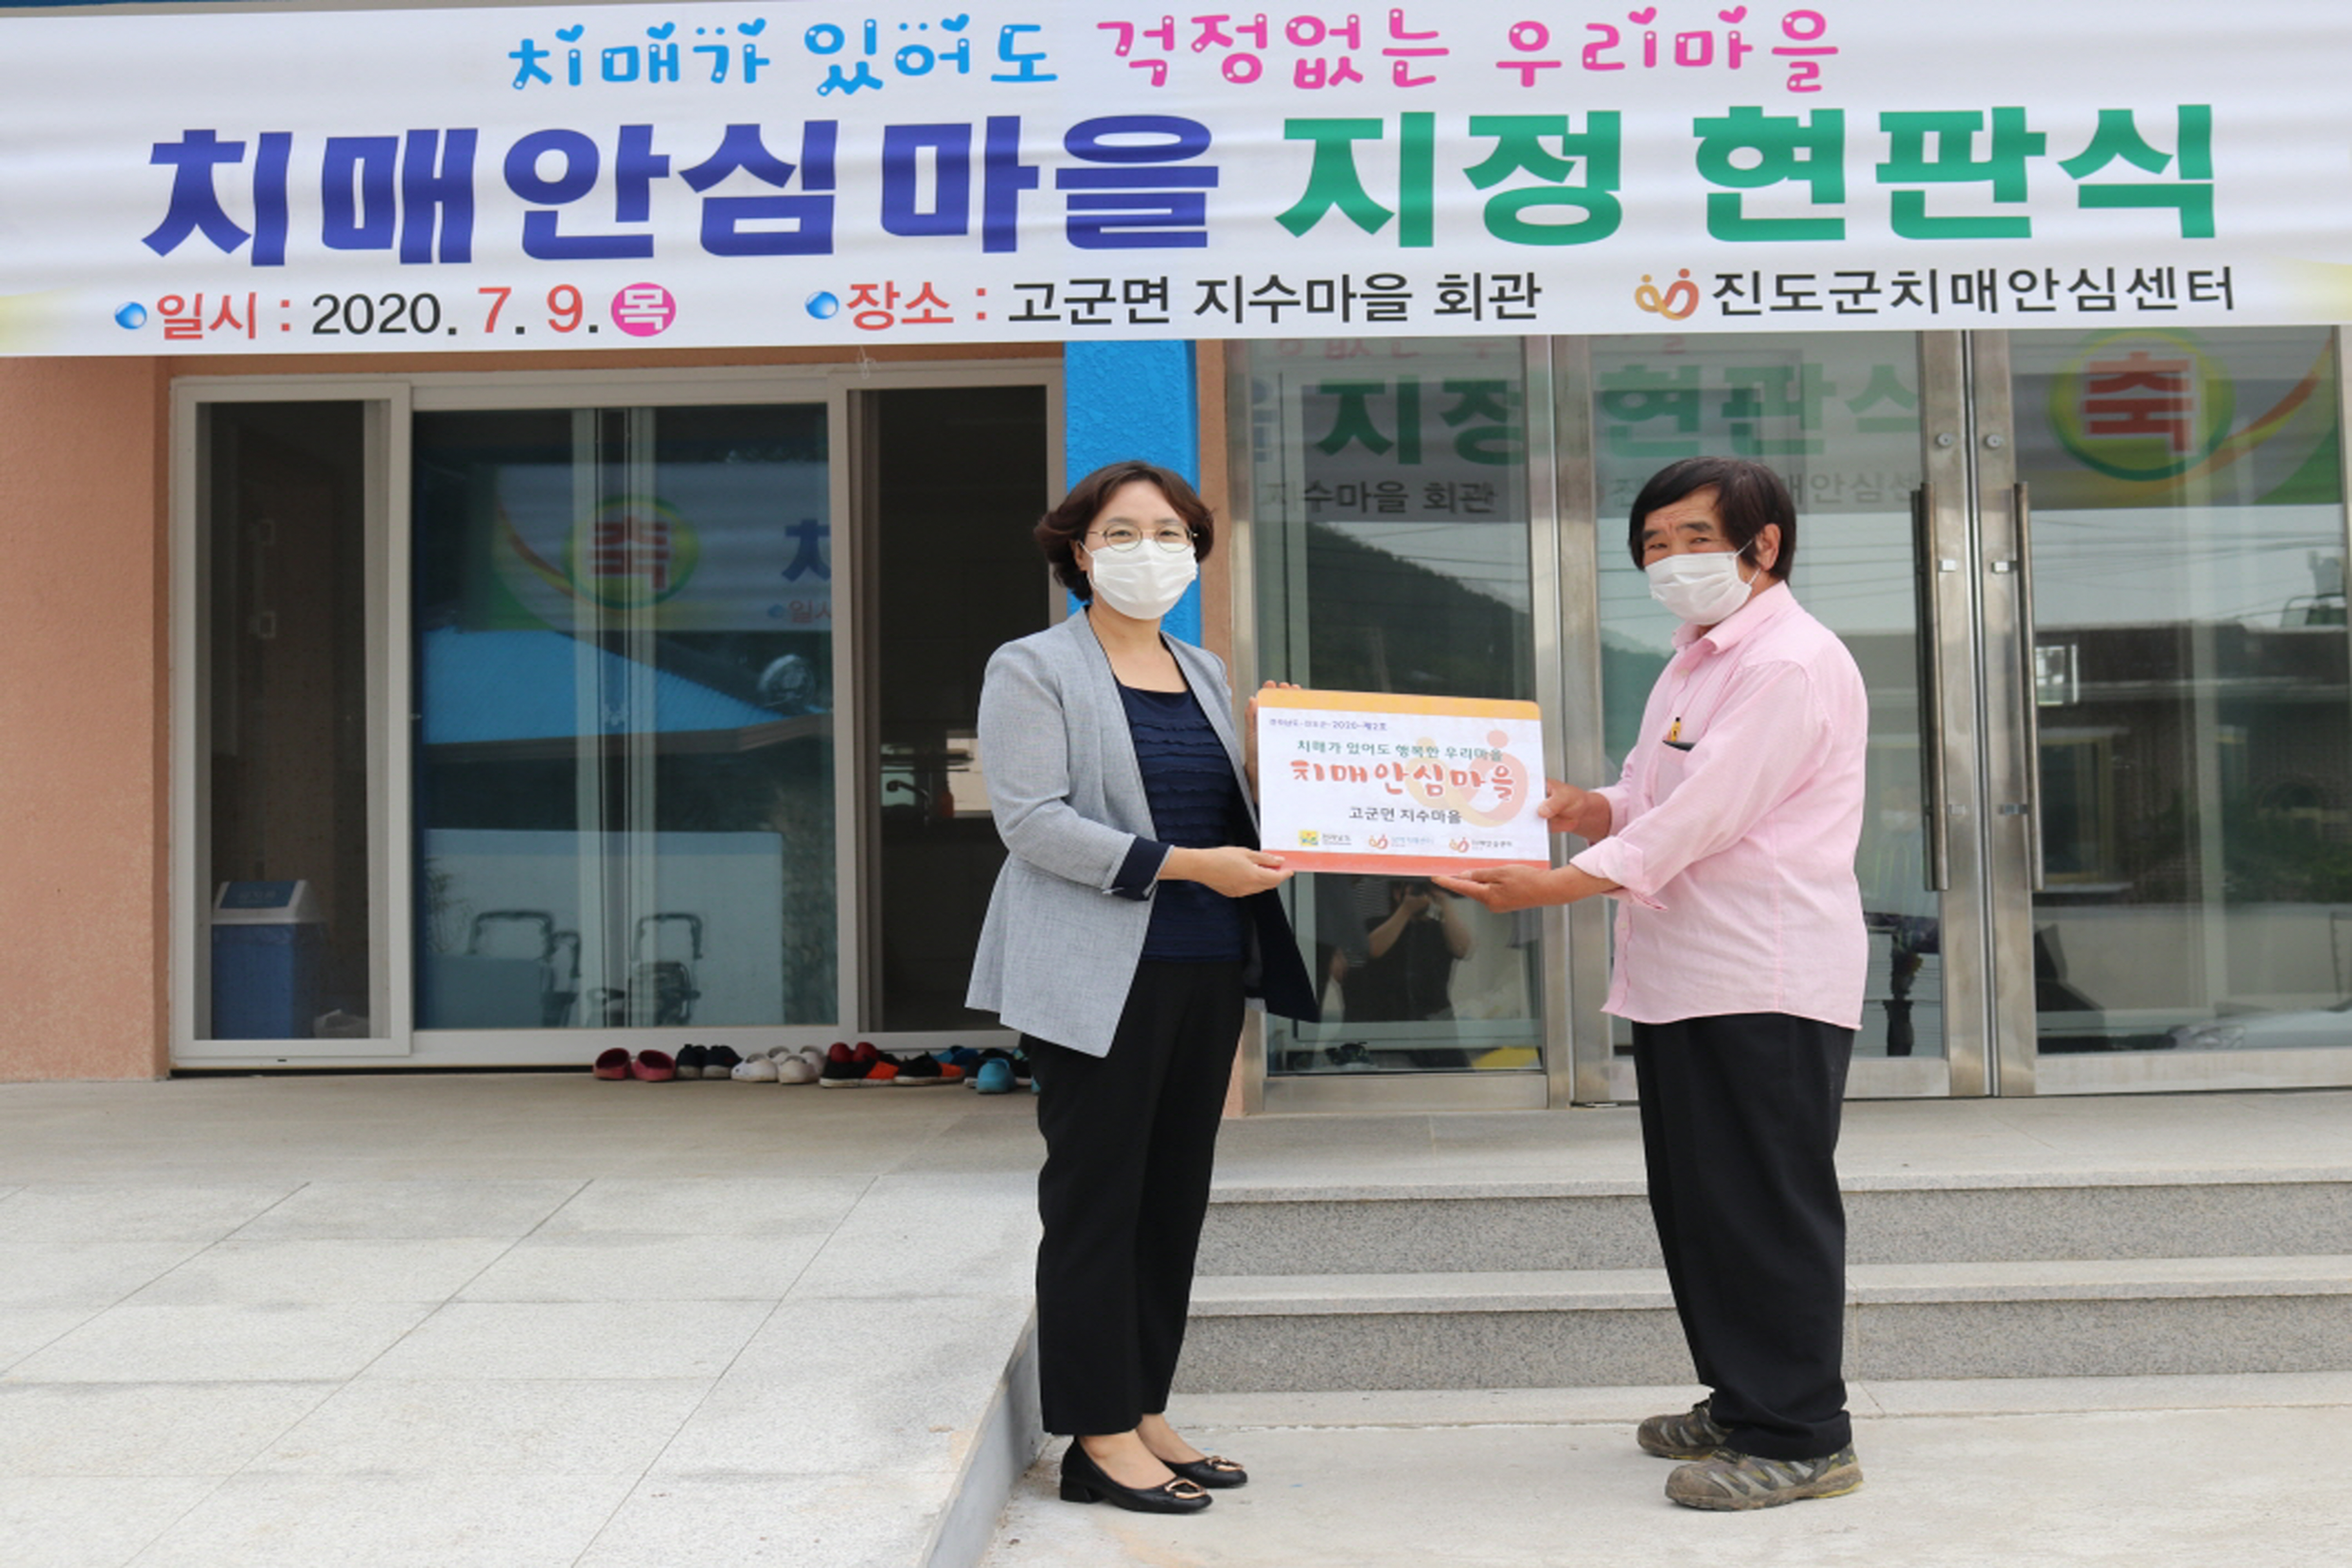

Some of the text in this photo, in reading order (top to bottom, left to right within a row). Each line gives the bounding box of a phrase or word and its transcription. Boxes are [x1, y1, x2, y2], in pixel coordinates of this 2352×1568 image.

[507, 5, 1838, 97] 치매가 있어도 걱정없는 우리마을
[142, 104, 2215, 266] 치매안심마을 지정 현판식
[156, 293, 256, 339] 일시
[312, 293, 457, 335] 2020.
[478, 287, 525, 334] 7.
[546, 284, 598, 334] 9.
[619, 289, 670, 331] 목
[847, 281, 954, 330] 장소
[1008, 276, 1170, 325] 고군면
[1194, 274, 1413, 324] 지수마을
[1434, 272, 1542, 321] 회관
[1712, 266, 2234, 316] 진도군치매안심센터
[1297, 740, 1504, 762] 치매가 있어도 행복한 우리마을
[1290, 760, 1514, 800] 치매안심마을
[1349, 806, 1462, 825] 고군면 지수마을
